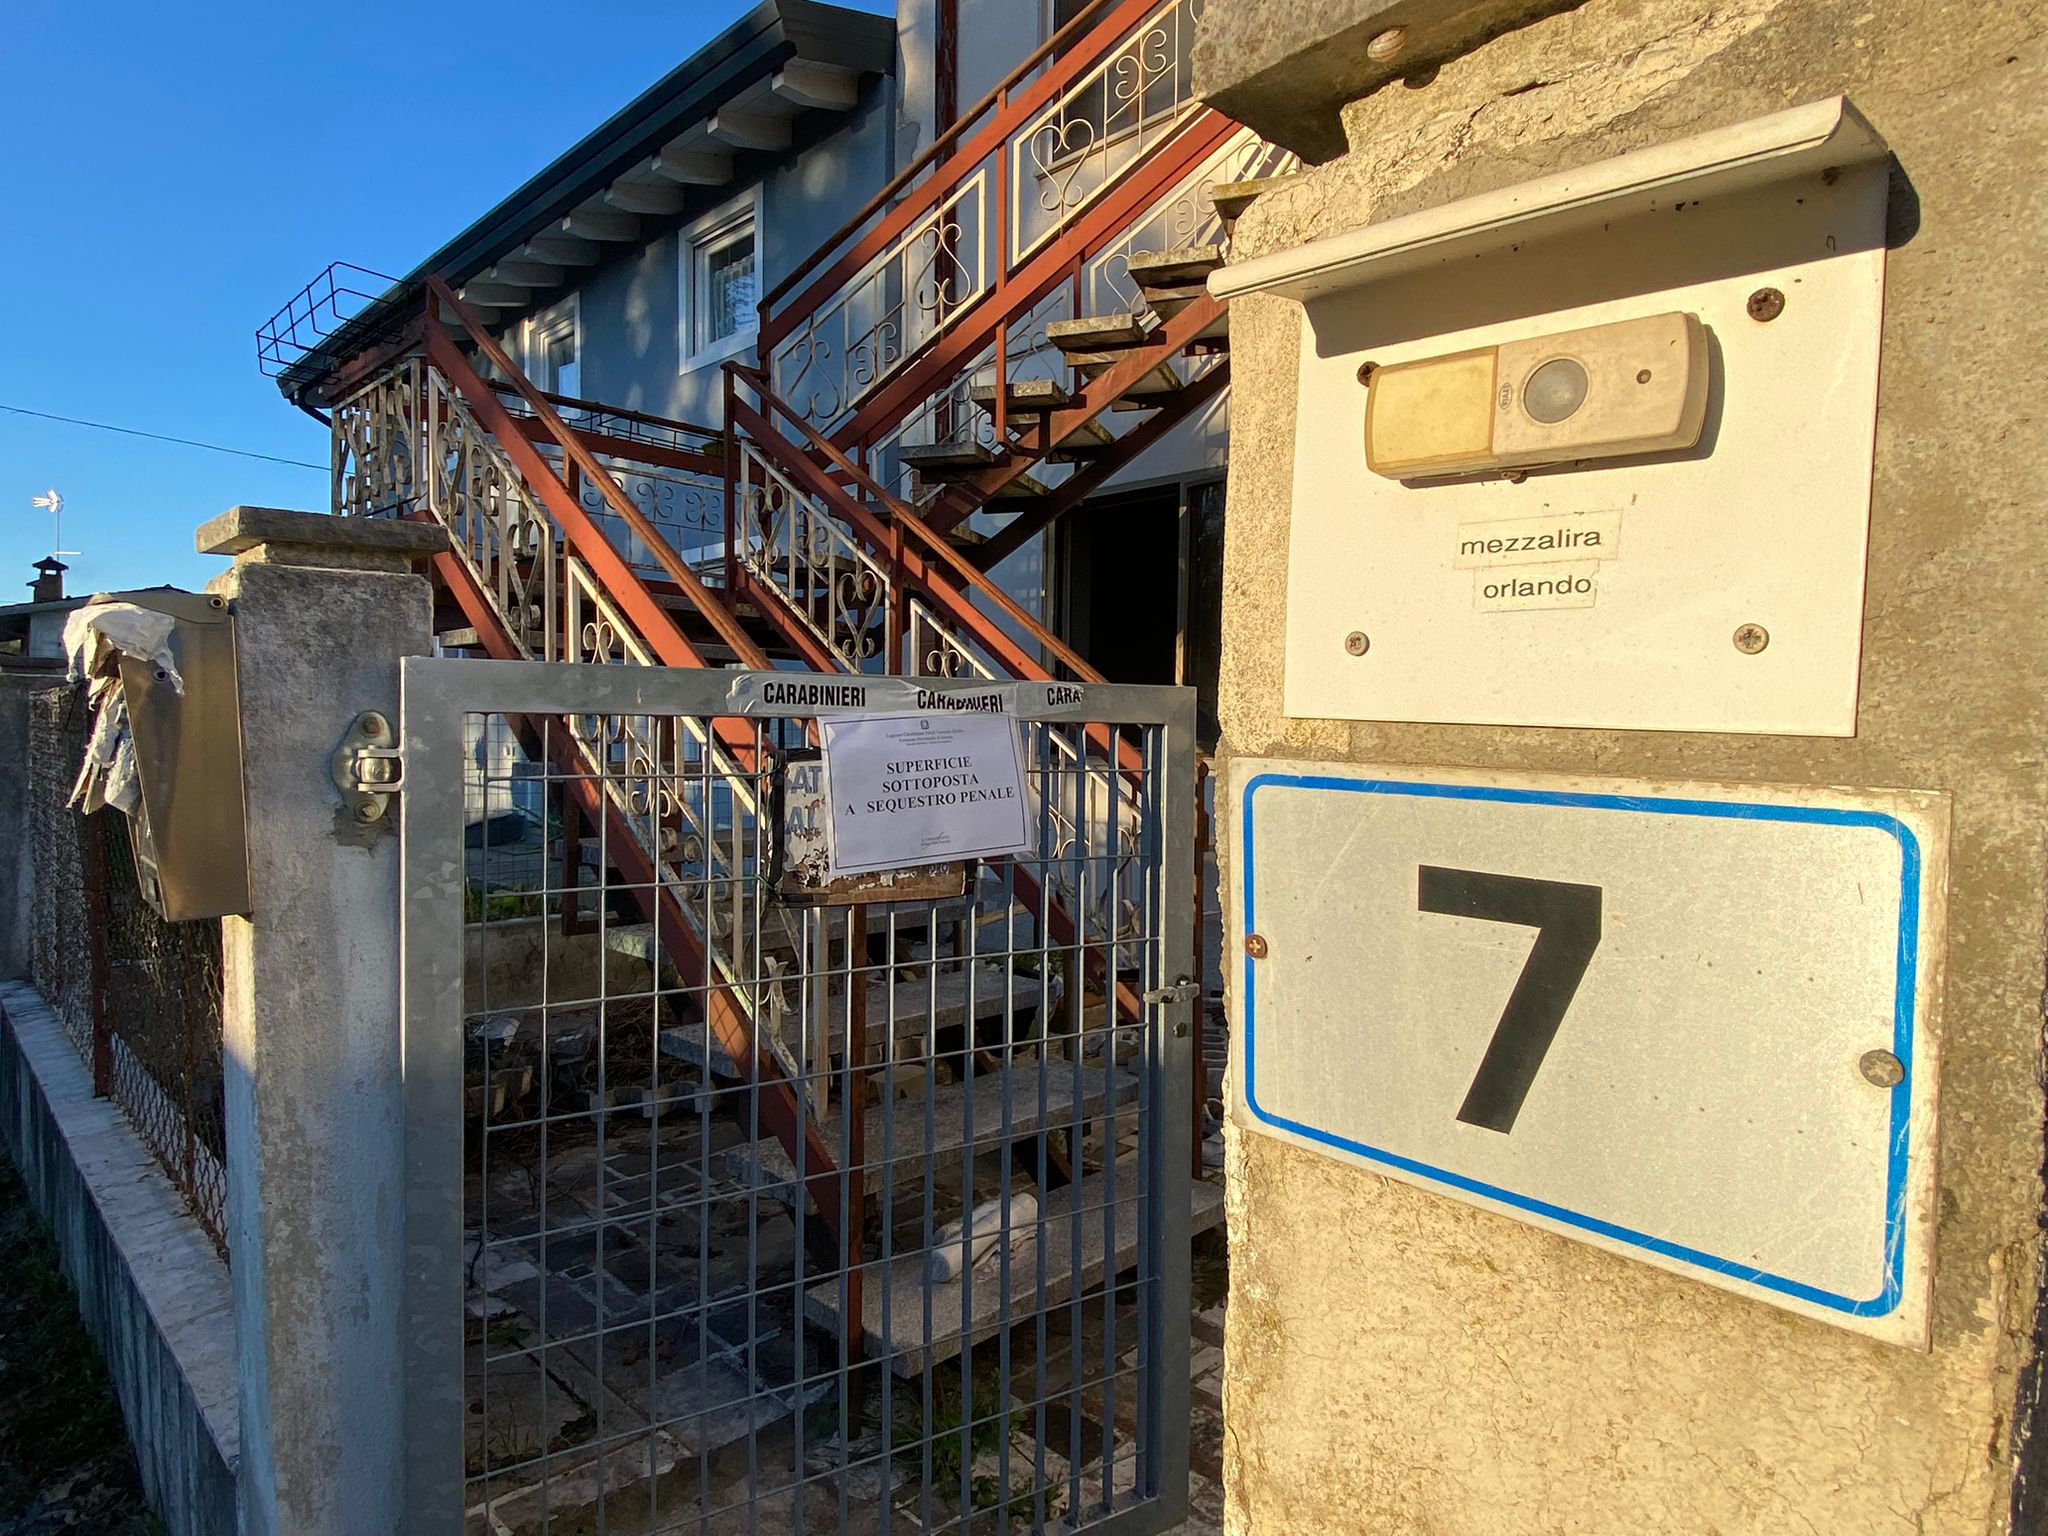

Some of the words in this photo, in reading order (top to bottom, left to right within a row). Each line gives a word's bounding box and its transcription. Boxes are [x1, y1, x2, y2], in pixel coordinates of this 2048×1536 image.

[1461, 528, 1601, 555] mezzalira
[1483, 575, 1592, 600] orlando
[763, 682, 866, 708] CARABINIERI
[887, 756, 971, 775] SUPERFICIE
[882, 775, 979, 793] SOTTOPOSTA
[844, 805, 856, 816] A
[866, 794, 957, 812] SEQUESTRO
[960, 787, 1015, 805] PENALE
[1418, 865, 1602, 1134] 7
